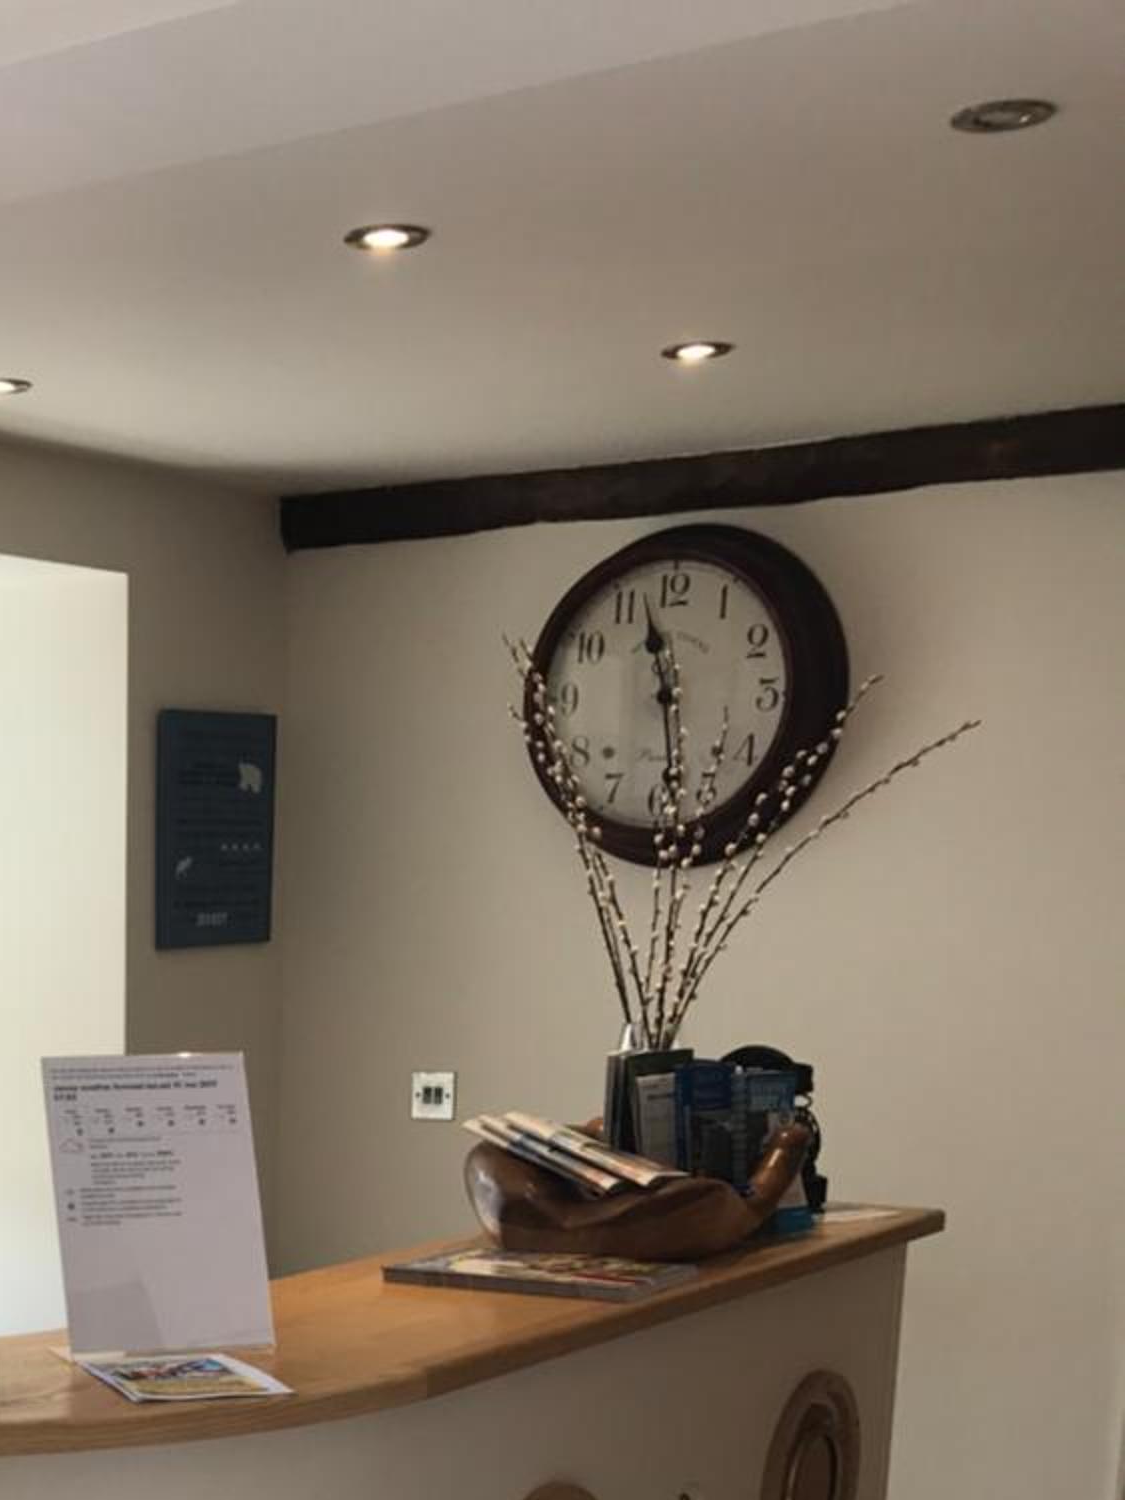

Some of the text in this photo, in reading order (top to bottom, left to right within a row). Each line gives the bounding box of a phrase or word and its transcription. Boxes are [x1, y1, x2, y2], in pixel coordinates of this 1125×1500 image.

[615, 589, 635, 624] 11
[660, 573, 690, 608] 12
[719, 583, 728, 620] 1
[576, 630, 605, 664] 10
[746, 623, 769, 659] 2
[561, 684, 579, 716] 9
[756, 677, 780, 711] 3
[570, 735, 591, 767] 8
[733, 733, 756, 766] 4
[604, 773, 624, 804] 7
